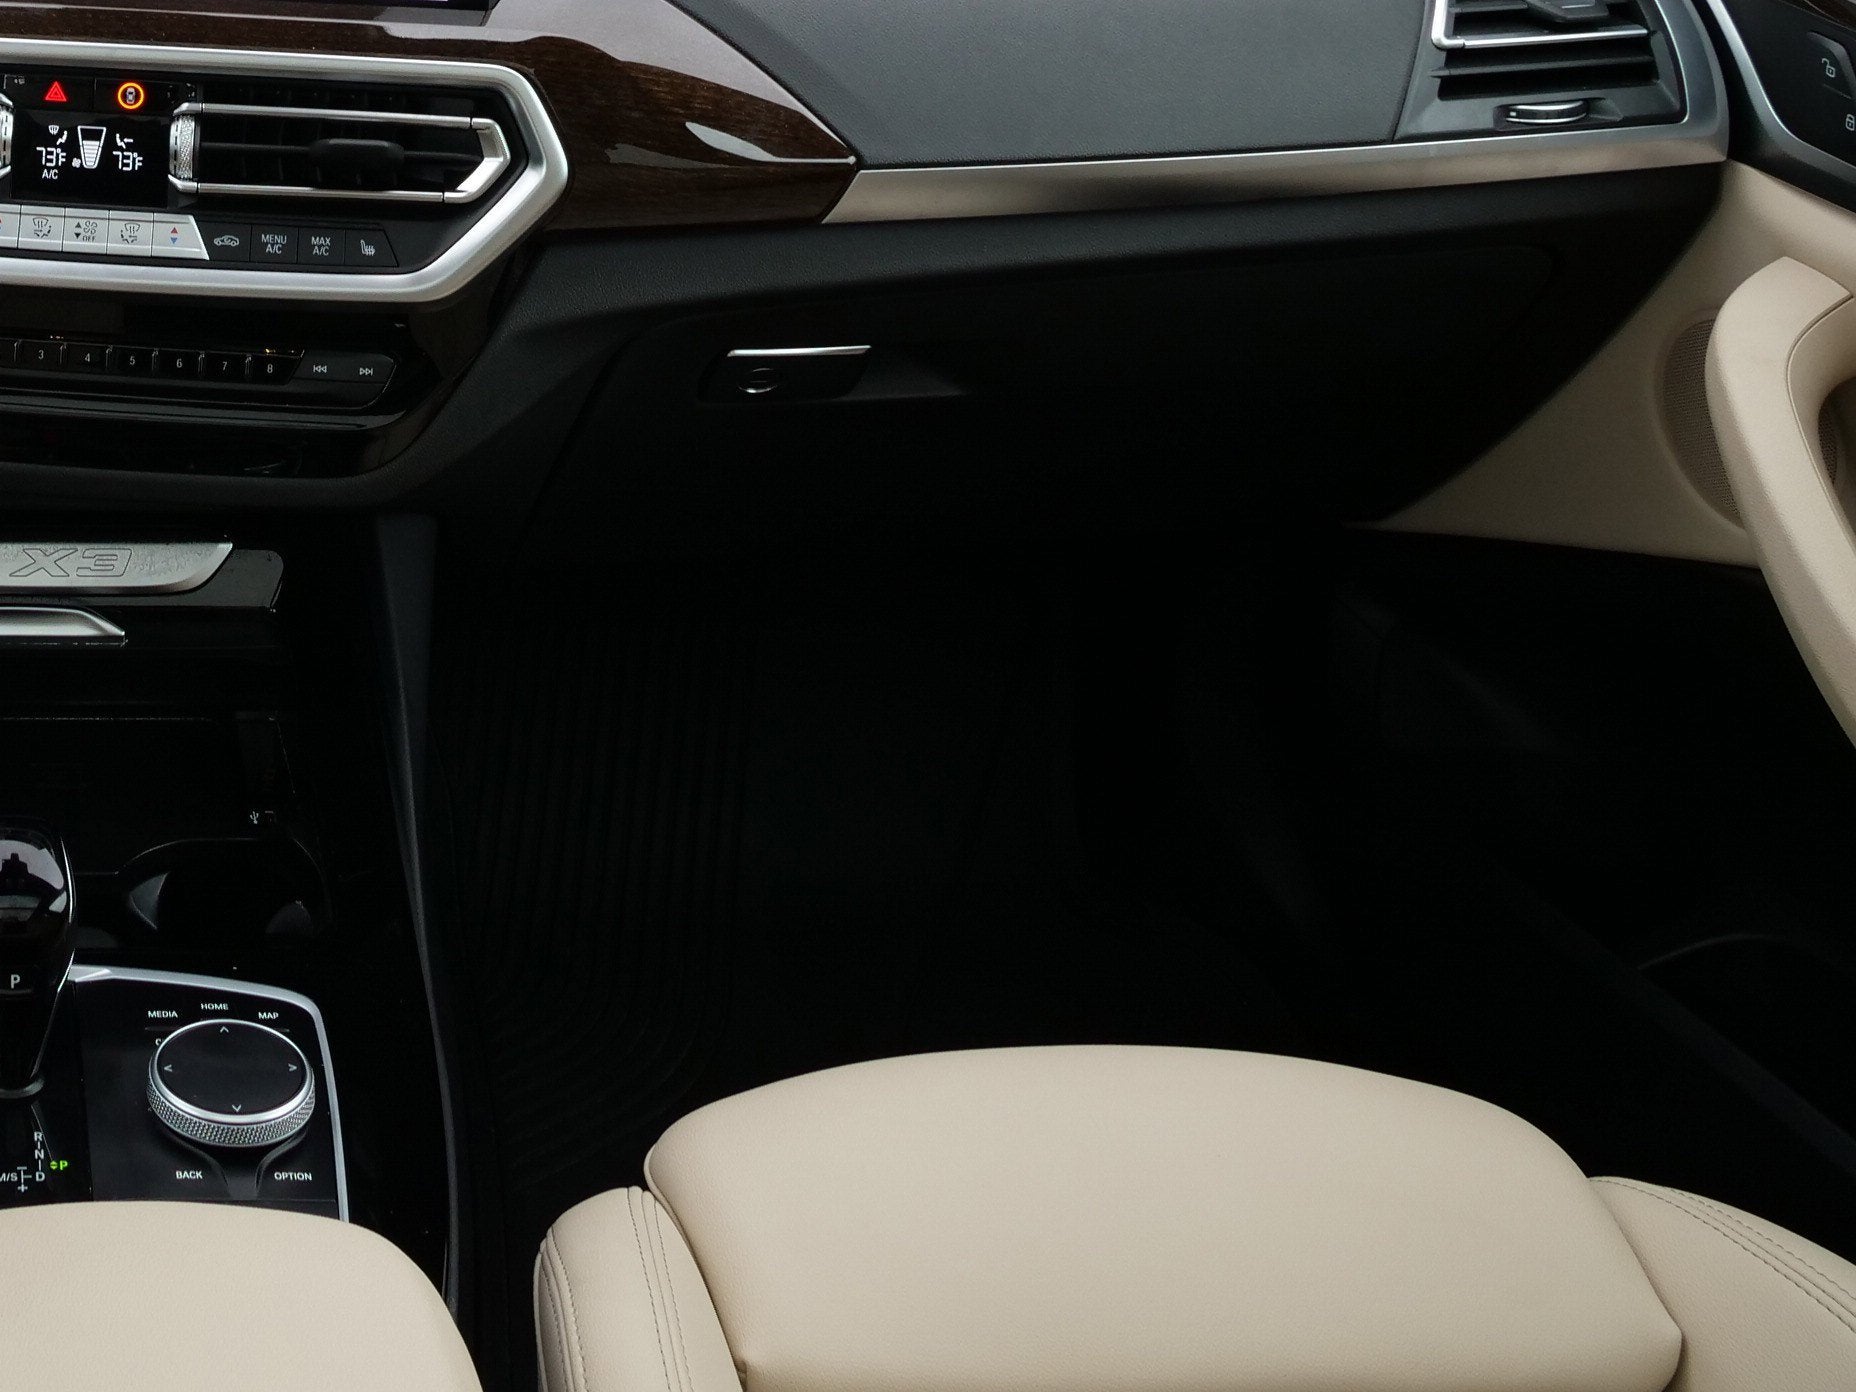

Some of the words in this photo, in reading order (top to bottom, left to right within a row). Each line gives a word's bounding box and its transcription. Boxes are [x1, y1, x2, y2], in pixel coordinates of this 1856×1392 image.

[42, 168, 59, 180] A/C
[261, 234, 287, 245] MENU
[311, 236, 331, 247] MAX
[265, 243, 282, 255] A/C
[312, 245, 329, 257] A/C
[38, 350, 44, 360] 3
[84, 353, 91, 363] 4
[129, 356, 136, 366] 5
[176, 359, 183, 369] 6
[222, 361, 228, 371] 7
[267, 364, 273, 373] 8
[9, 547, 133, 578] X3
[10, 974, 21, 989] P
[200, 1002, 229, 1011] HOME
[147, 1010, 179, 1019] MEDIA
[258, 1011, 279, 1020] MAP
[34, 1131, 43, 1141] R
[34, 1149, 45, 1159] N
[59, 1160, 68, 1170] P
[35, 1172, 46, 1182] D
[175, 1170, 203, 1180] BACK
[274, 1171, 312, 1181] OPTION
